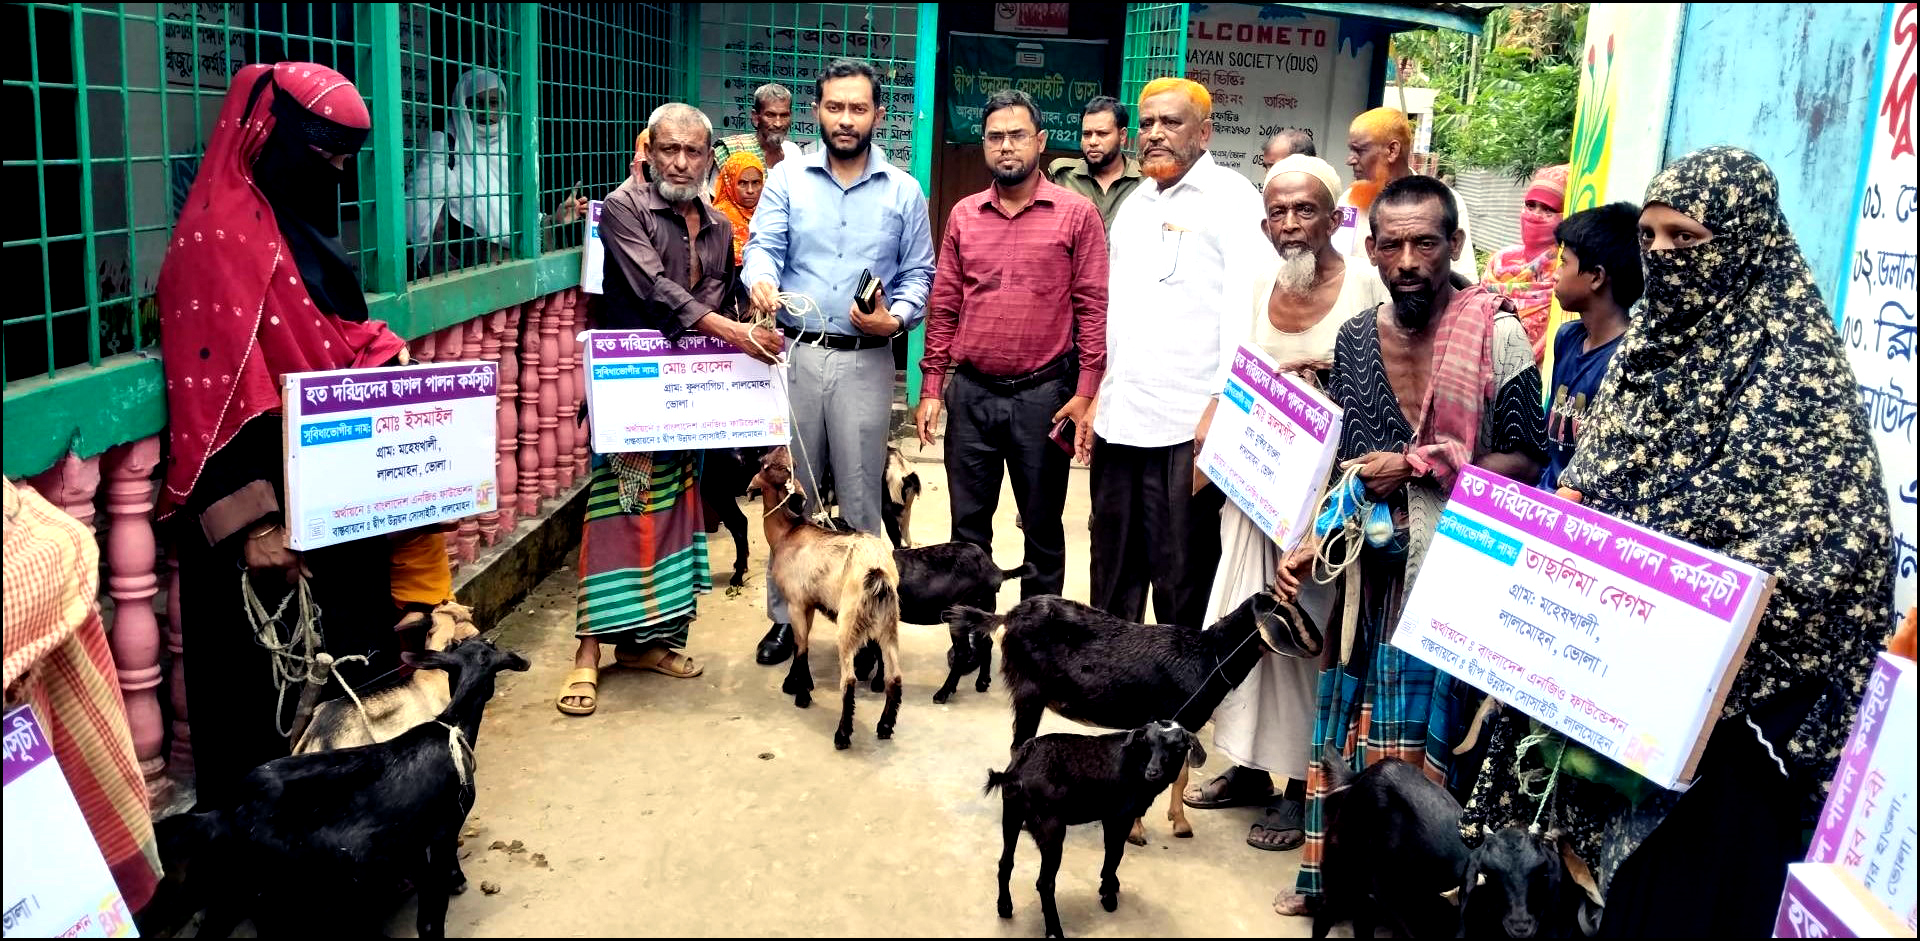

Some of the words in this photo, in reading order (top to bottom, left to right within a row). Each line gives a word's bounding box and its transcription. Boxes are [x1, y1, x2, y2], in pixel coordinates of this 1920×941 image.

[1297, 27, 1326, 48] TO
[594, 338, 617, 352] হত
[662, 362, 687, 375] মোঃ
[691, 360, 733, 374] হোসেন
[304, 385, 329, 405] হত
[331, 377, 388, 402] দরিদ্রদের
[391, 377, 422, 397] ছাগল
[425, 374, 456, 393] পালন
[457, 365, 494, 393] কর্মসূচী
[375, 415, 400, 434] মোঃ
[404, 407, 453, 429] ইসমাইল
[1460, 471, 1490, 497] হত
[1491, 483, 1561, 529] দরিদ্রদের
[1563, 514, 1612, 550] ছাগল
[1615, 537, 1667, 575] পালন
[1670, 558, 1743, 606] কর্মসূচী
[1526, 548, 1598, 596] তাছলিমা
[1599, 585, 1656, 623] বেগম
[1478, 643, 1526, 678] বাংলাদেশ
